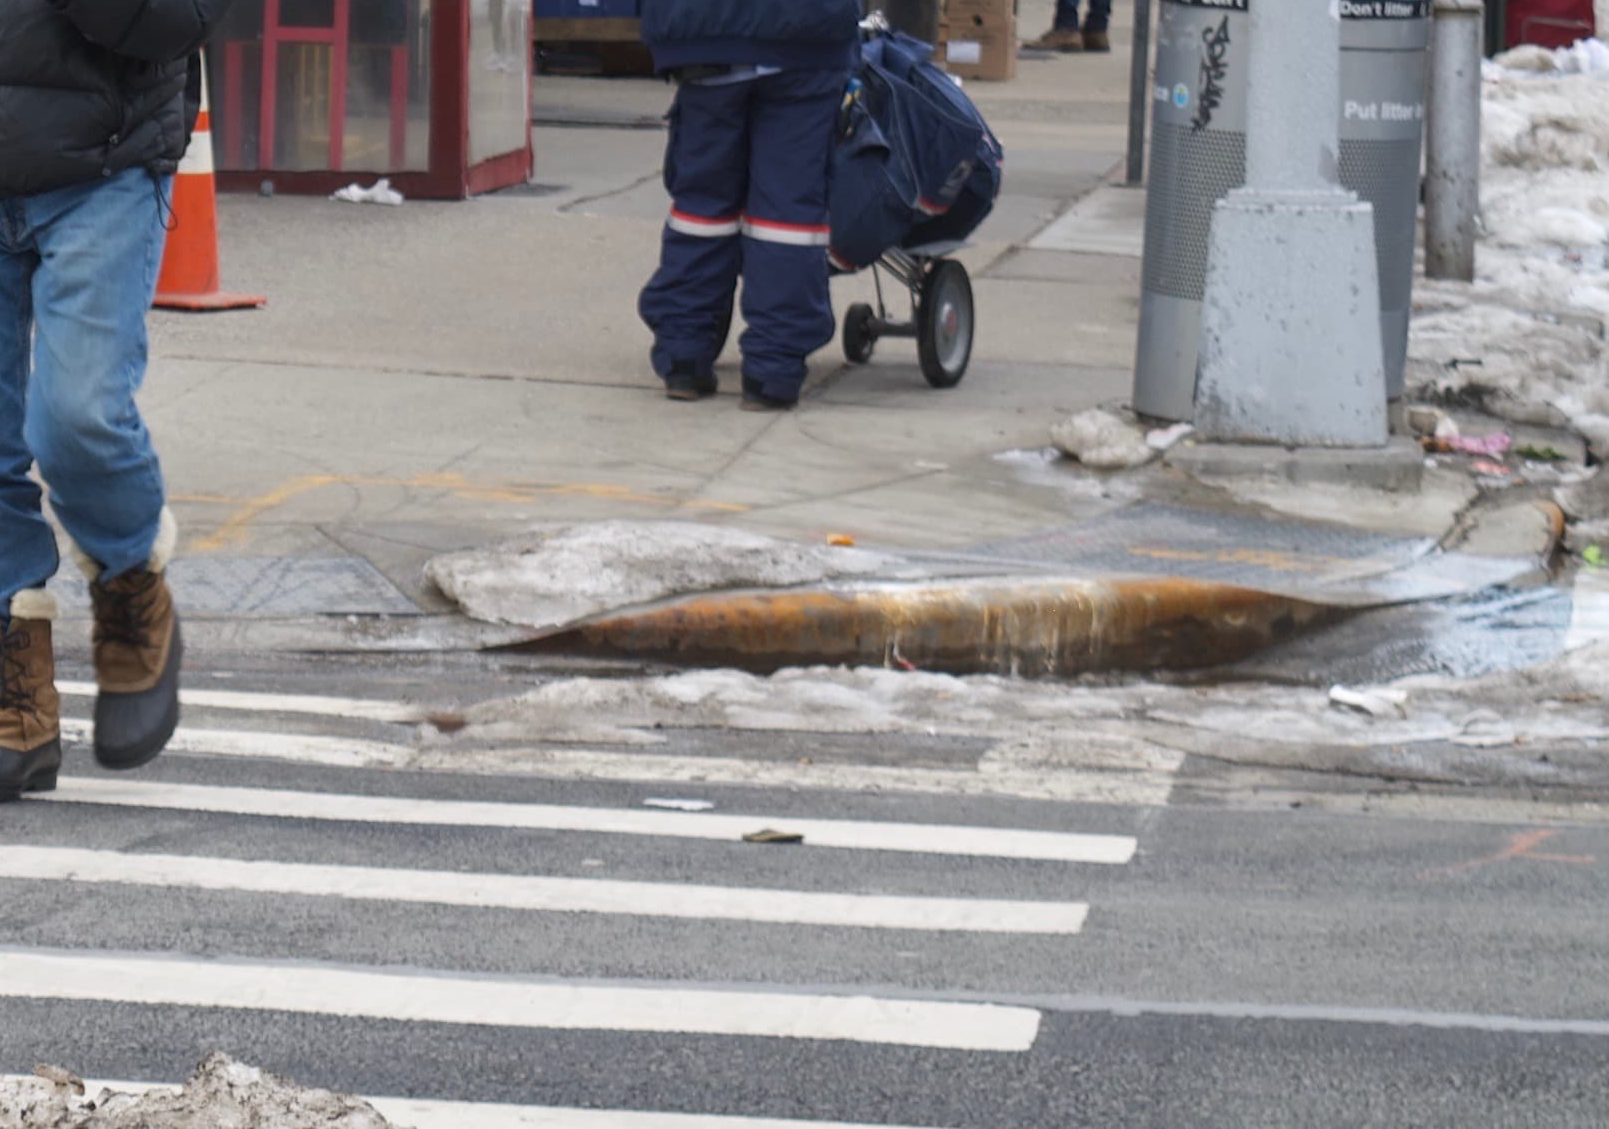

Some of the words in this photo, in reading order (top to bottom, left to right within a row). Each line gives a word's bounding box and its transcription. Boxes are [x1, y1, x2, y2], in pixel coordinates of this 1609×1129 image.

[1340, 1, 1382, 18] Don't
[1384, 2, 1413, 18] litter
[1344, 101, 1377, 120] Put
[1380, 101, 1413, 120] litter
